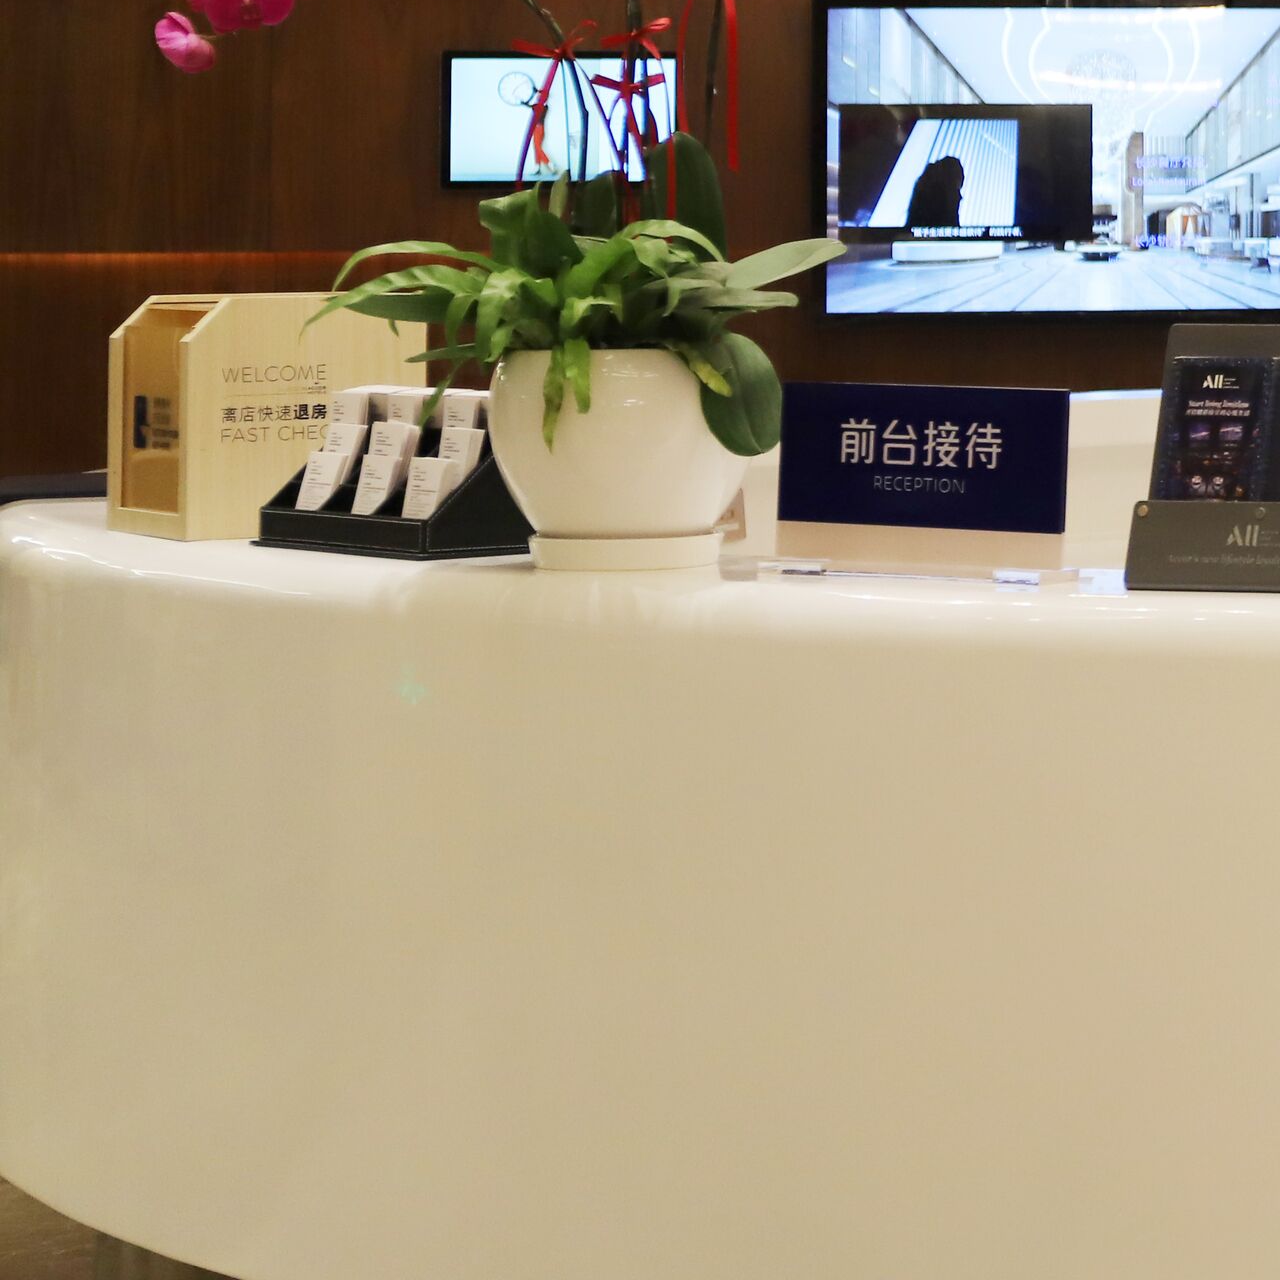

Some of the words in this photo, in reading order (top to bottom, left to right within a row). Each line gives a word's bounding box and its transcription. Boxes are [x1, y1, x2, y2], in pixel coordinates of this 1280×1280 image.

[221, 364, 327, 384] WELCOME
[221, 403, 328, 423] 离店快速退房
[220, 426, 271, 443] FAST
[840, 418, 1003, 470] 前台接待
[872, 475, 967, 494] RECEPTION
